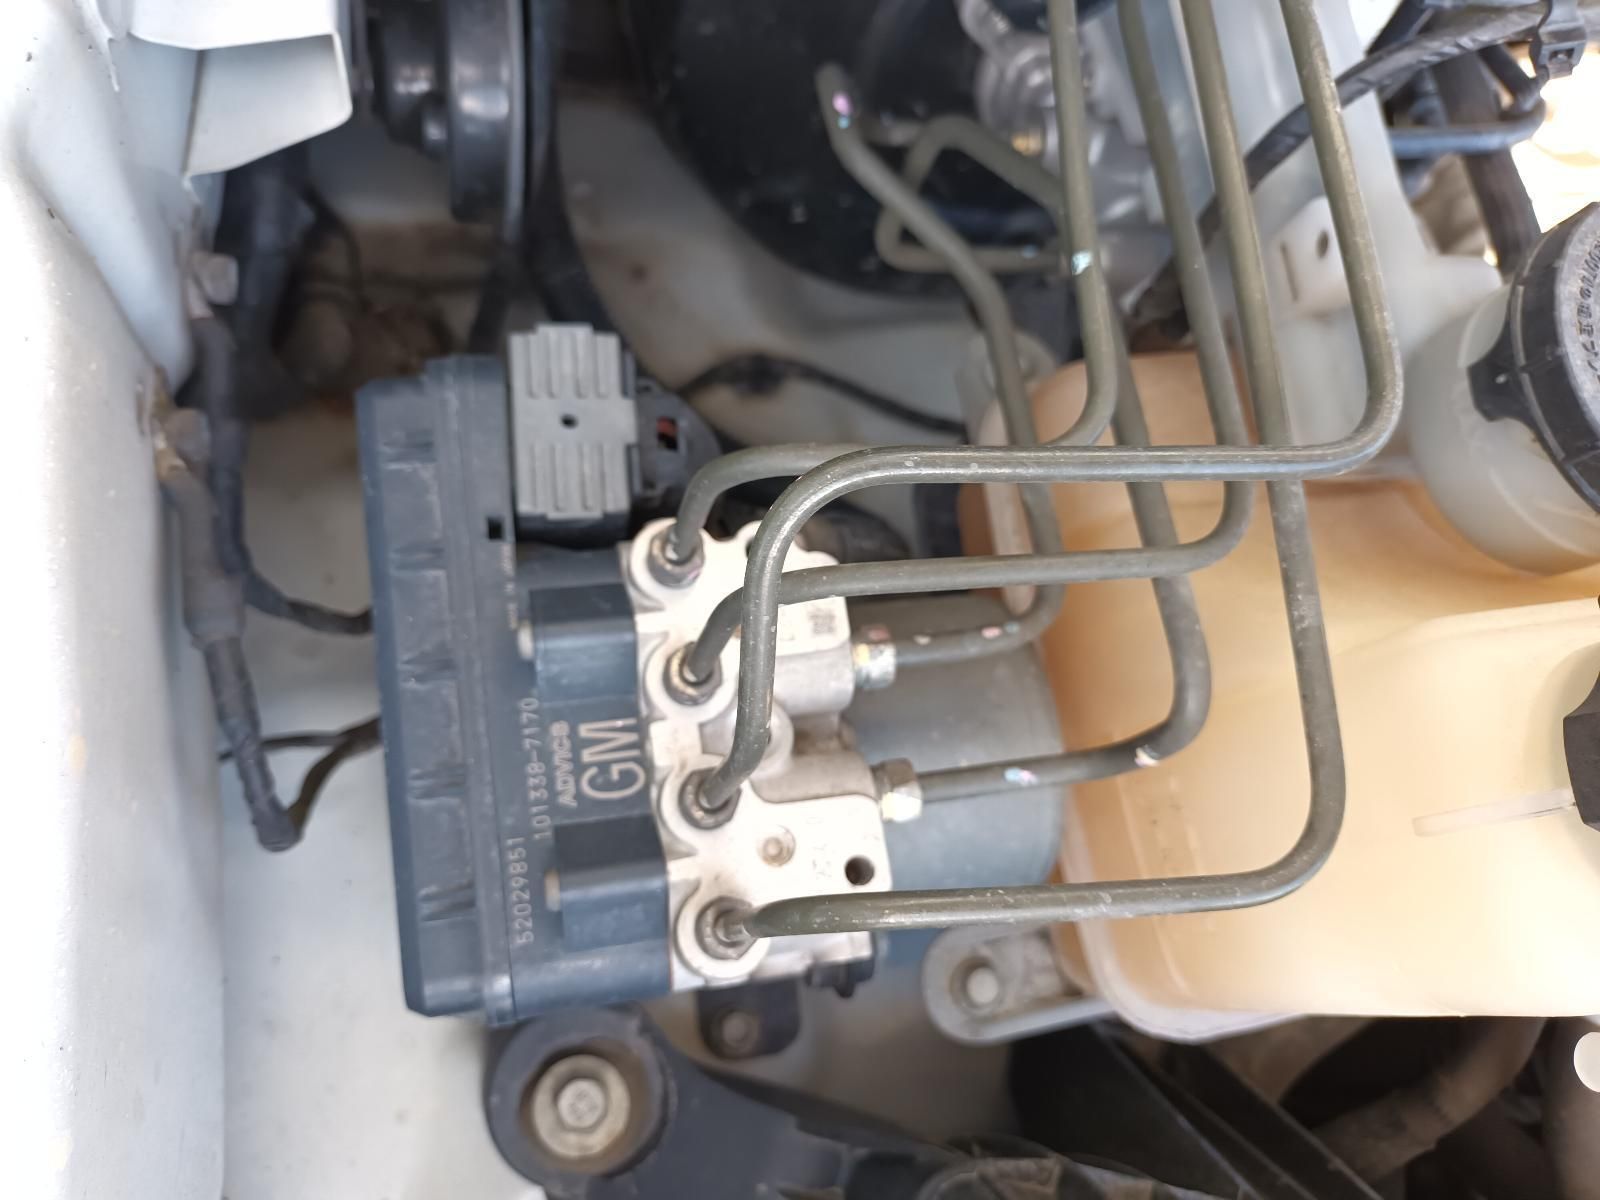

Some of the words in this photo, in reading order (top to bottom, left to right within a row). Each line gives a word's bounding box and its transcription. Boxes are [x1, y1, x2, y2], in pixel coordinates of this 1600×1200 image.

[520, 698, 551, 840] 101338-7170
[551, 720, 578, 807] ADVICS
[579, 718, 646, 799] GM
[506, 837, 535, 945] 52029851
